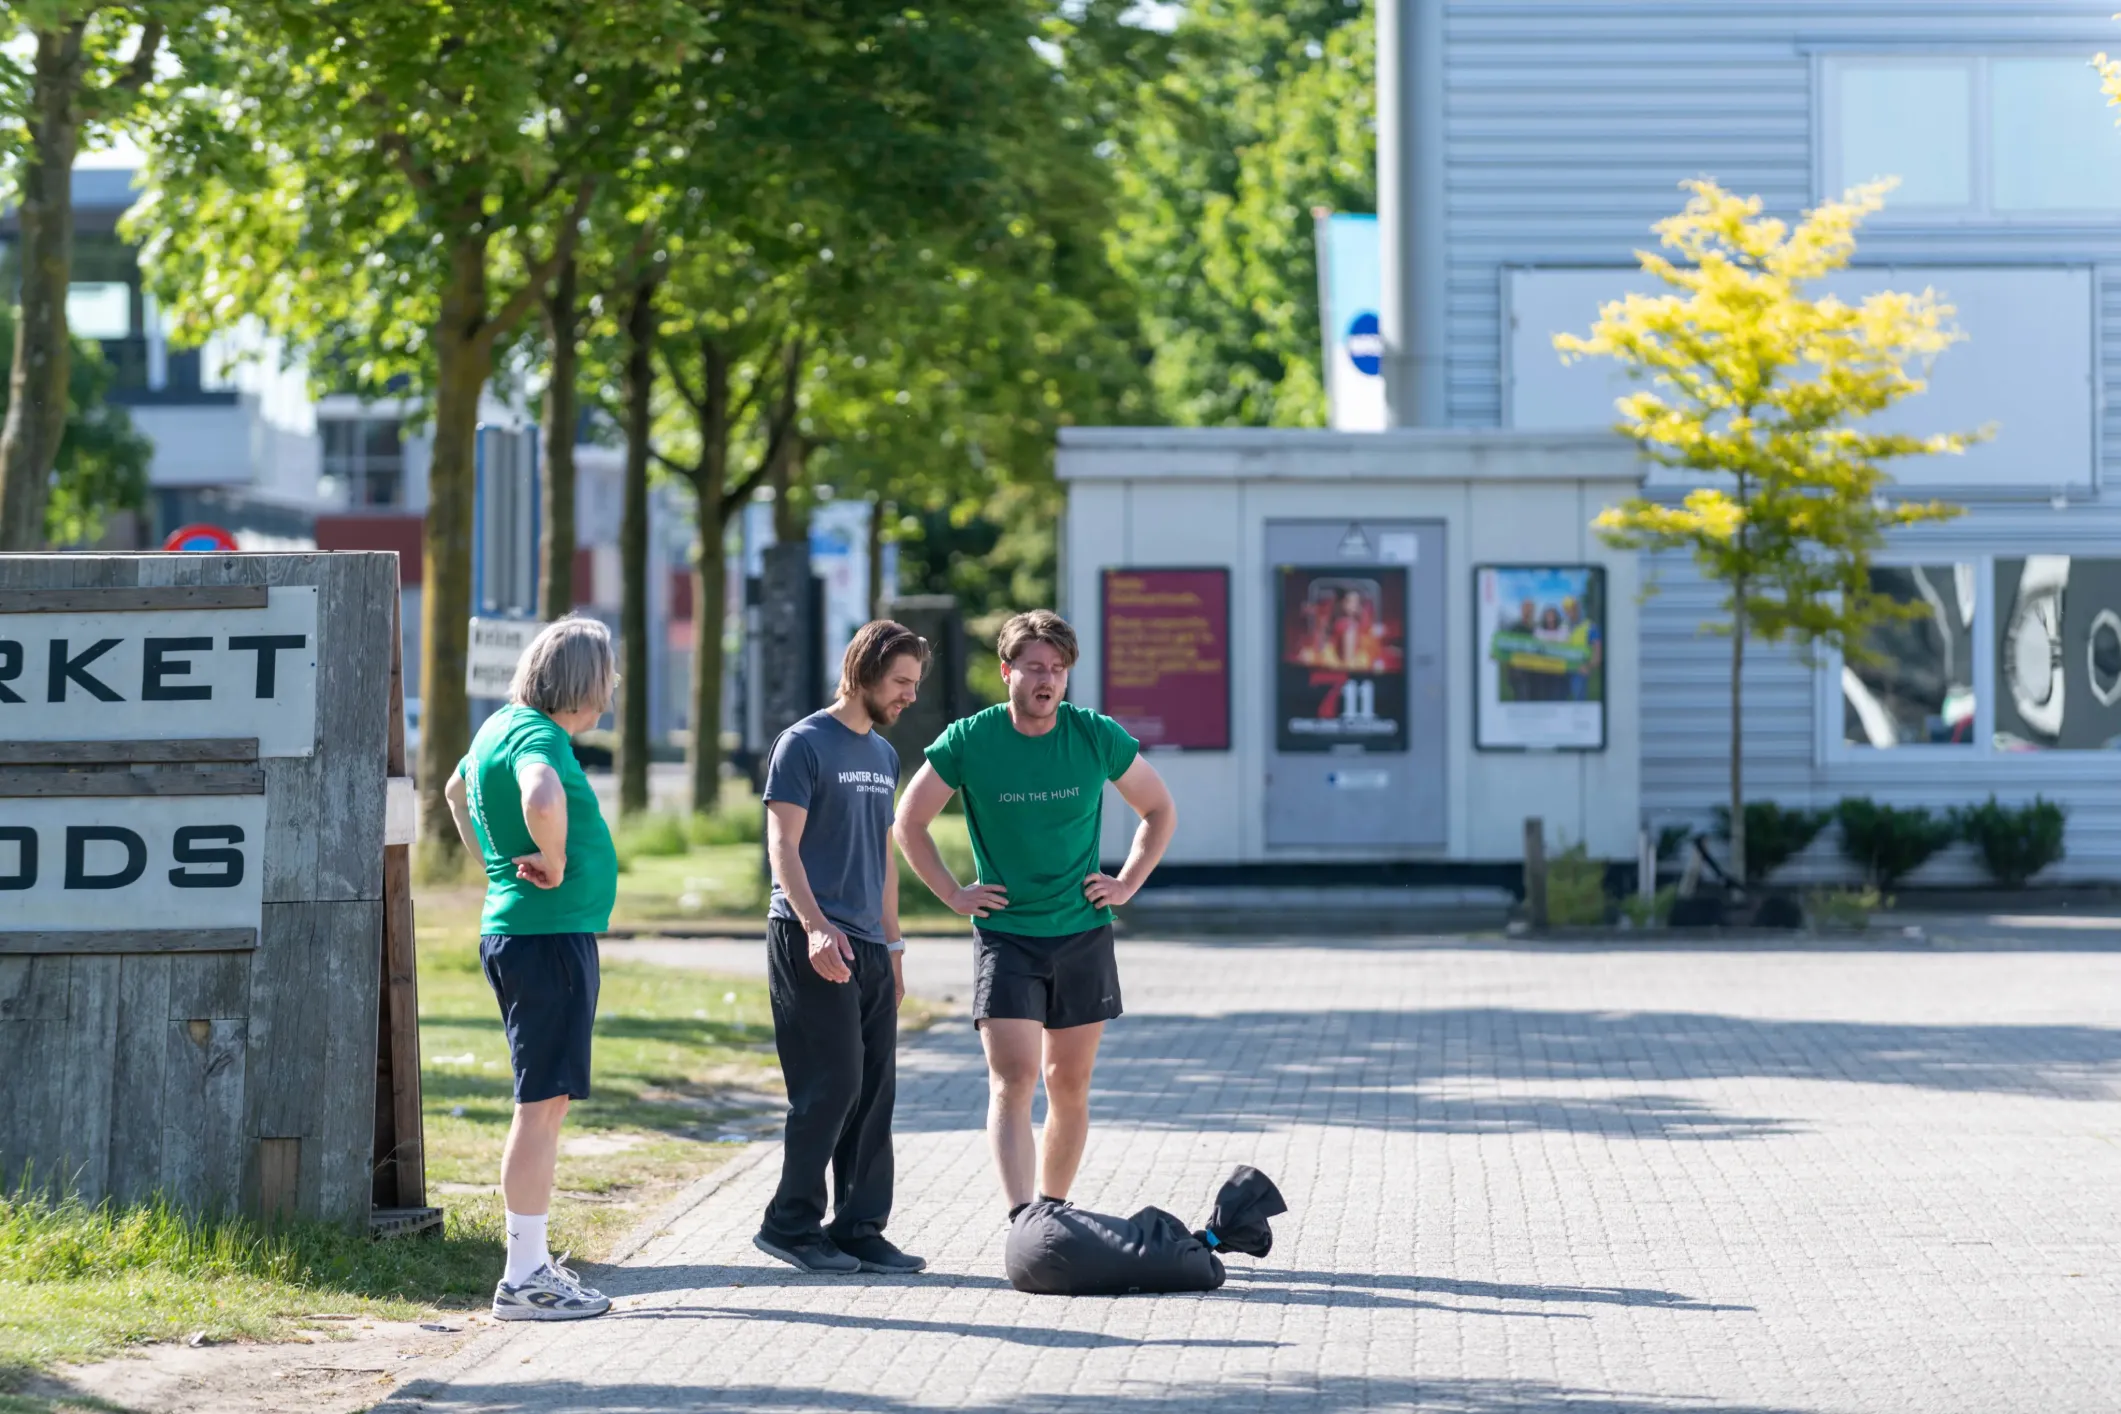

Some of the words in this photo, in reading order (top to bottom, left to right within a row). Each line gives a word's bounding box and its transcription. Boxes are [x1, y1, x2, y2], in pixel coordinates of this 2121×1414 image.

[838, 771, 872, 783] HUNTER
[875, 786, 889, 795] HUNT
[998, 793, 1025, 802] JOIN
[1028, 792, 1047, 801] THE
[1051, 787, 1080, 800] HUNT
[480, 809, 498, 857] ACADEMY
